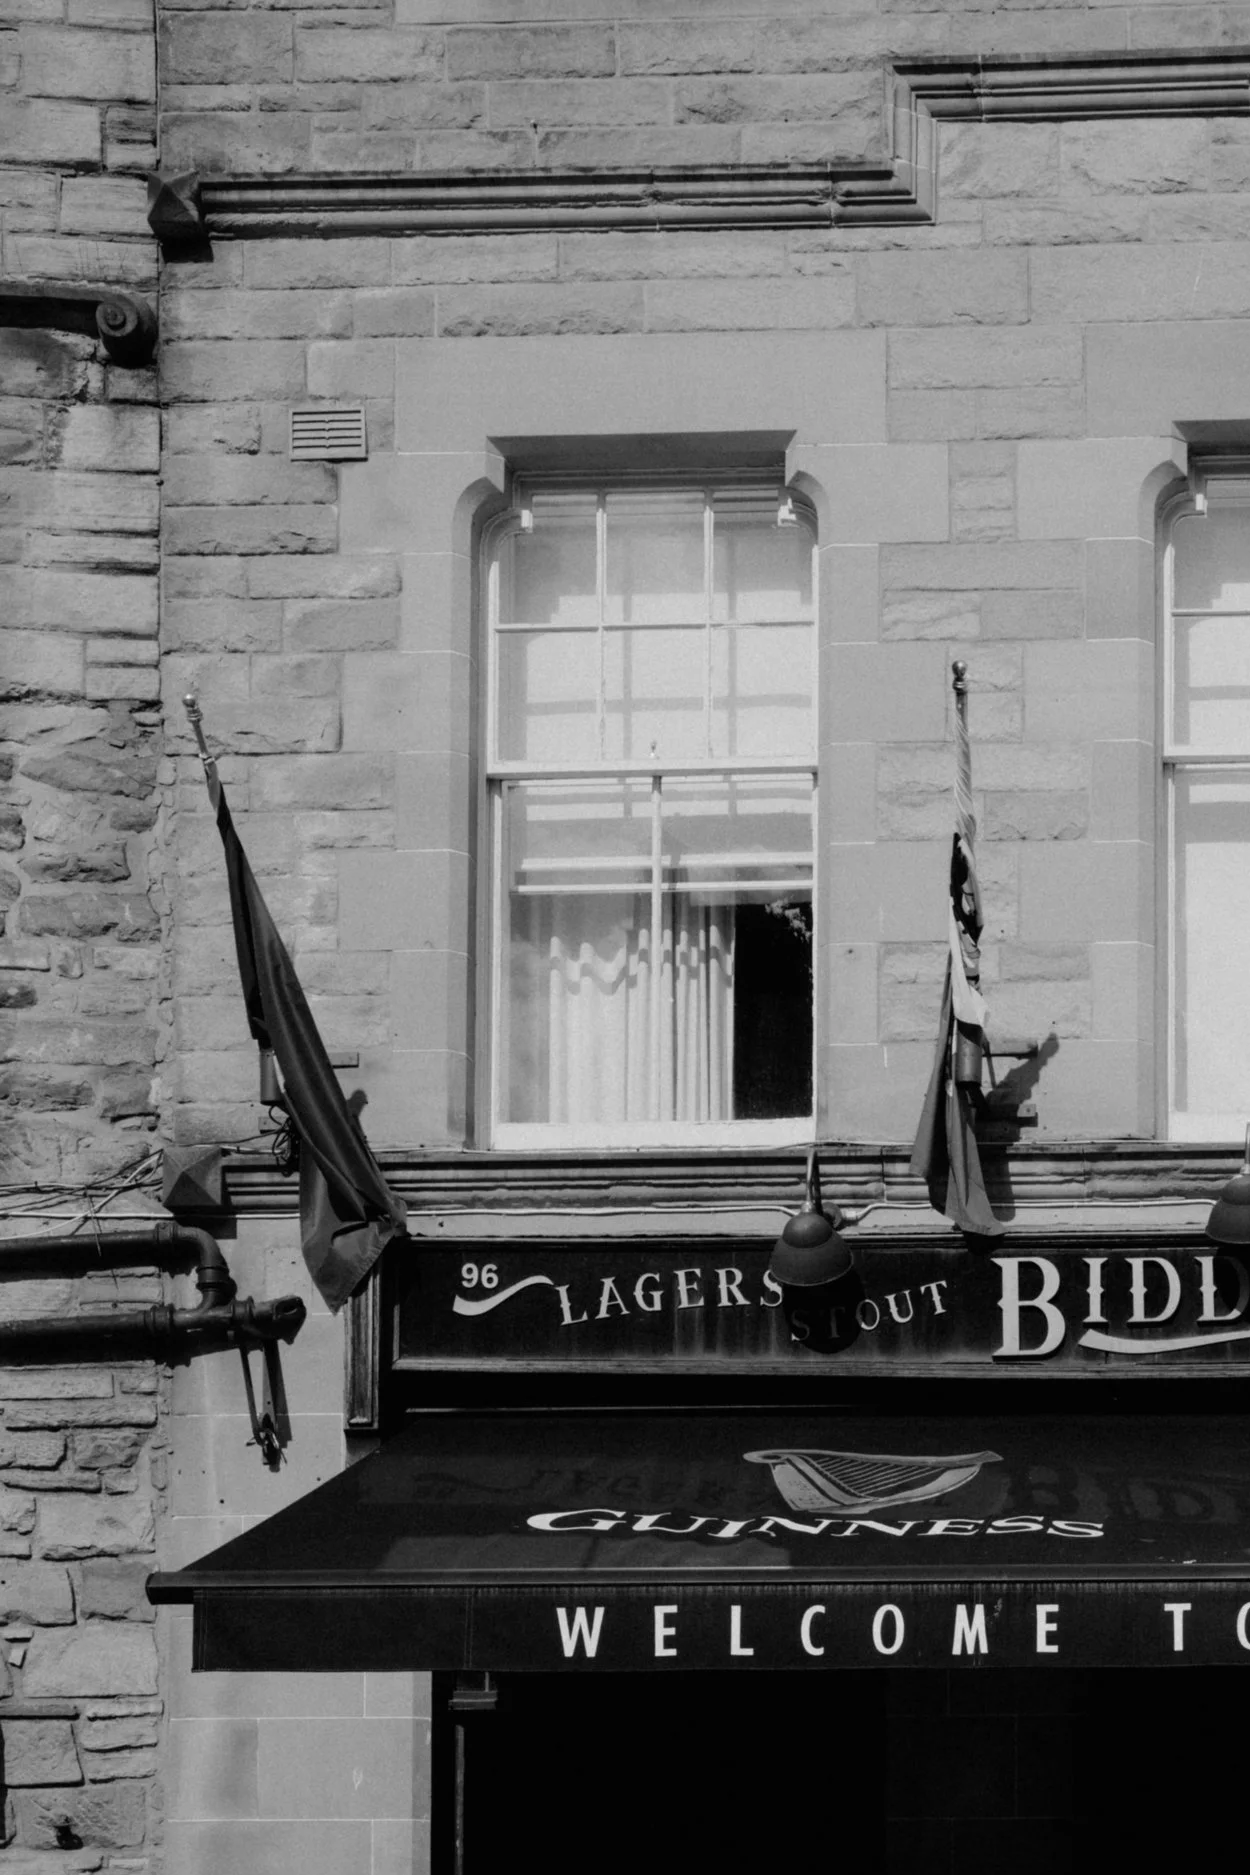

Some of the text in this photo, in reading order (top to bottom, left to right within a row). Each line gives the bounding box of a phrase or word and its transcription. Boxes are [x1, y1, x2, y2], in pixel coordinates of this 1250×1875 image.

[461, 1262, 500, 1289] 96
[556, 1267, 949, 1342] LAGERS STOUT
[526, 1509, 1106, 1538] GUINNESS
[556, 1603, 1060, 1658] WELCOME
